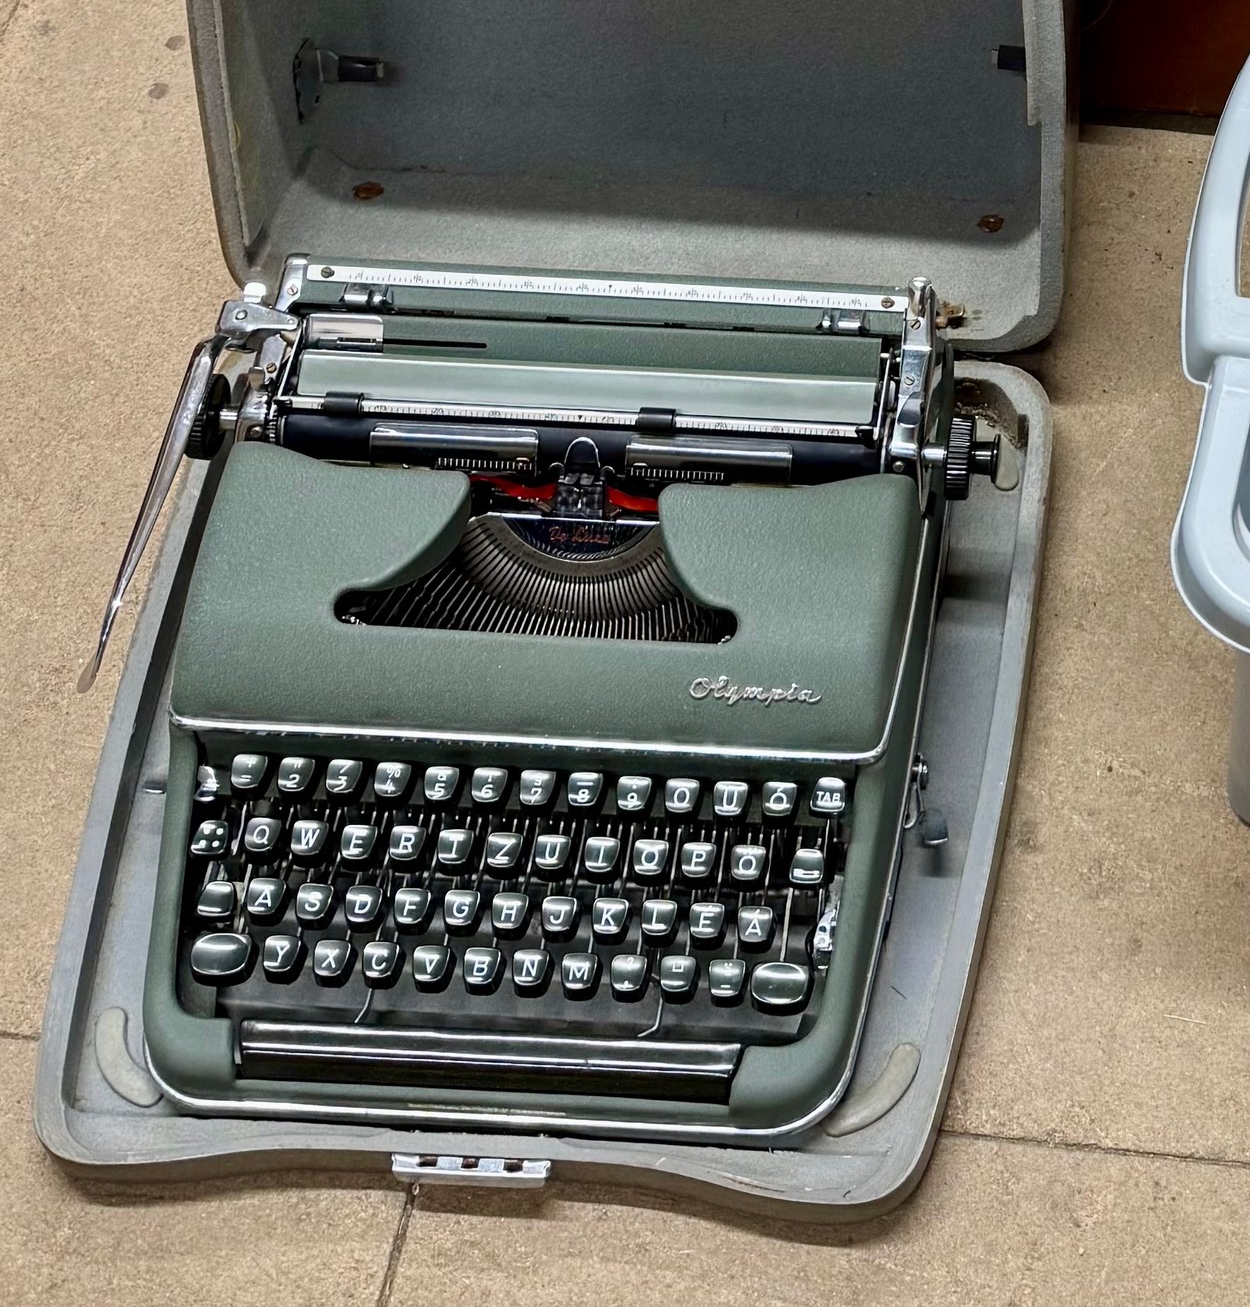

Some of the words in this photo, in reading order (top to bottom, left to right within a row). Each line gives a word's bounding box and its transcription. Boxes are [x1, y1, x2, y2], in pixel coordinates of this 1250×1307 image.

[689, 675, 822, 706] Olympia
[286, 774, 300, 787] 2
[333, 775, 347, 792] 3
[433, 783, 446, 799] 5
[481, 784, 494, 798] 6
[577, 788, 590, 802] 8
[816, 791, 841, 804] TAB
[254, 825, 269, 844] Q
[300, 829, 320, 847] W
[350, 834, 368, 855] E
[398, 834, 416, 853] R
[495, 841, 513, 861] Z
[545, 841, 561, 861] U
[691, 850, 707, 867] P
[253, 891, 272, 907] A
[304, 892, 322, 911] S
[353, 896, 371, 914] D
[402, 899, 420, 916] F
[452, 899, 471, 917] G
[500, 905, 518, 922] H
[549, 908, 565, 924] J
[601, 908, 617, 926] K
[651, 910, 666, 927] L
[274, 945, 290, 965] Y
[322, 950, 339, 968] X
[371, 952, 387, 970] C
[425, 955, 441, 973] V
[473, 959, 489, 976] B
[522, 960, 538, 977] N
[569, 964, 588, 980] M
